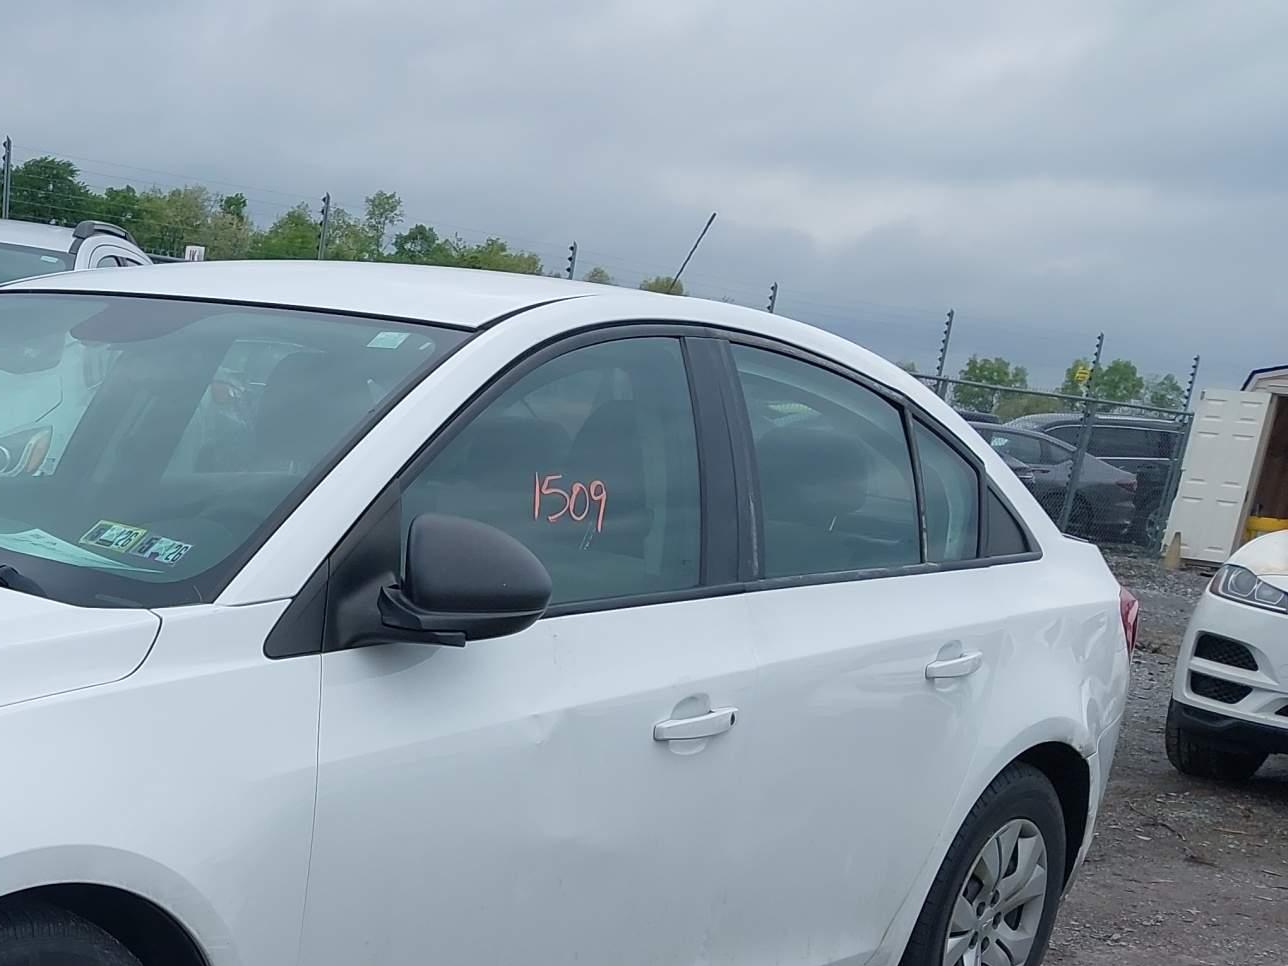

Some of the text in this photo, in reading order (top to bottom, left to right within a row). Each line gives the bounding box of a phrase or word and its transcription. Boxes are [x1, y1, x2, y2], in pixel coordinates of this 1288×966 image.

[534, 471, 607, 533] 1509
[114, 529, 140, 548] 26
[163, 544, 189, 562] 26
